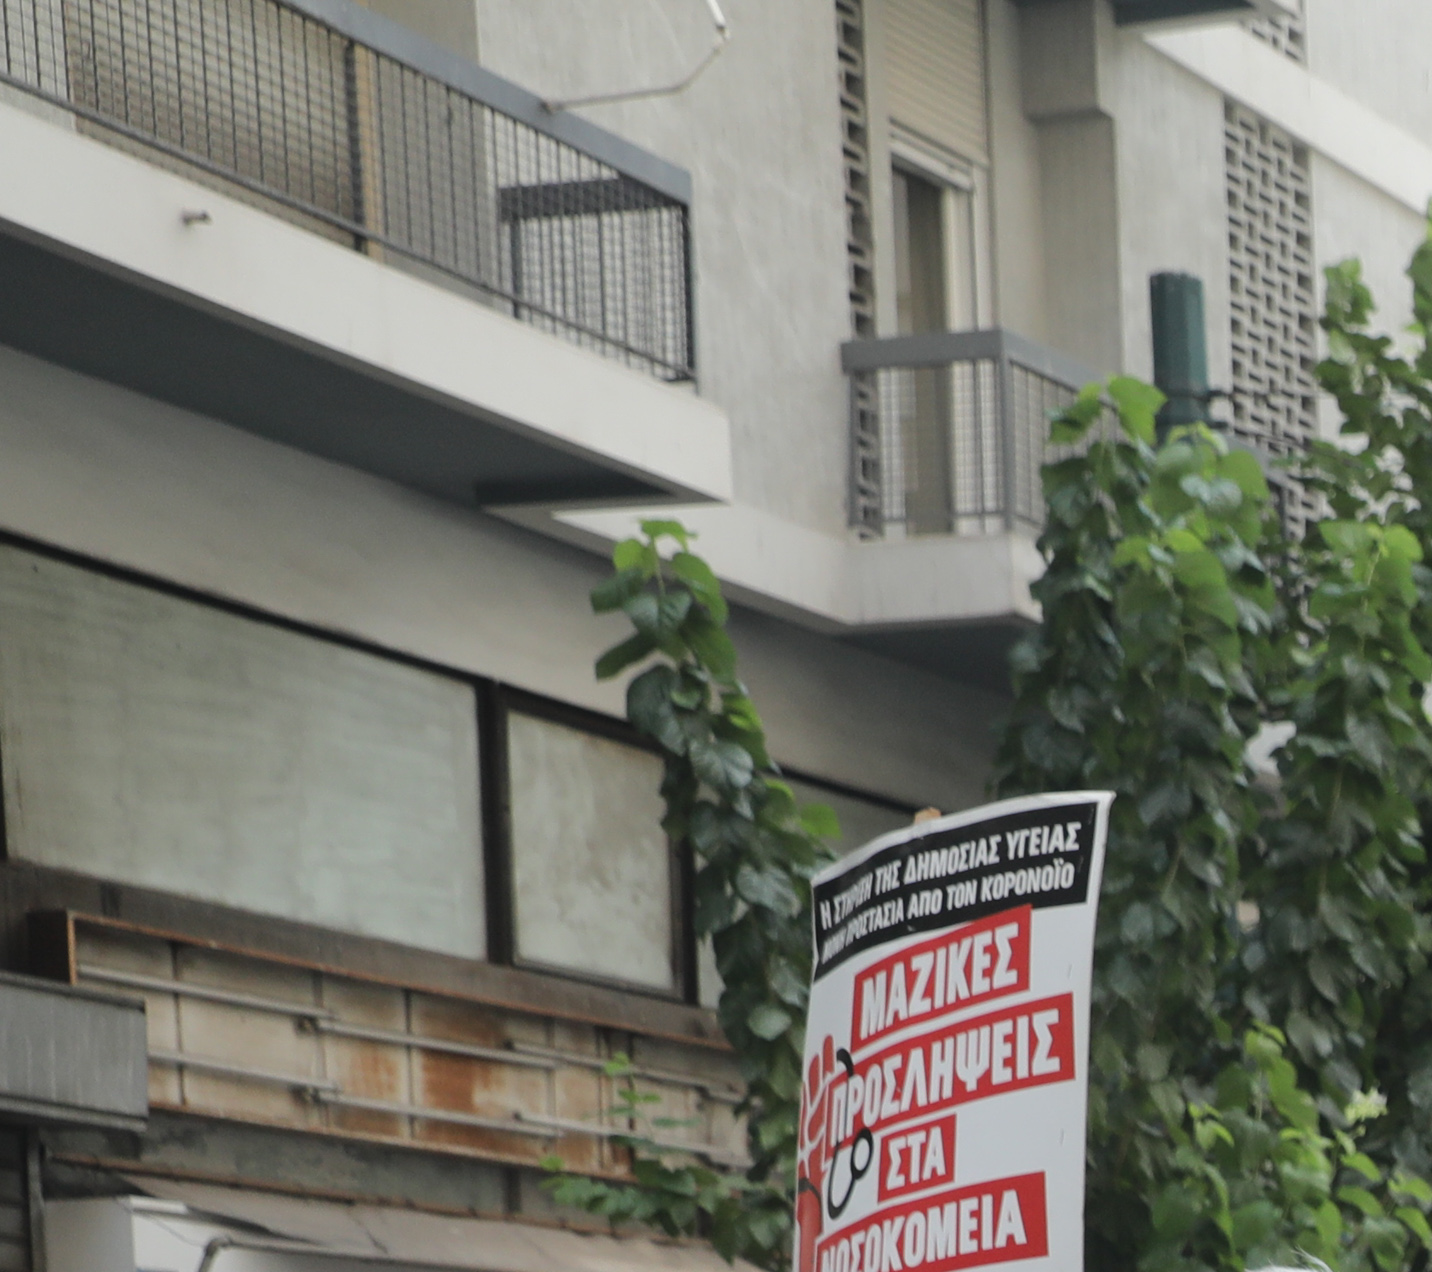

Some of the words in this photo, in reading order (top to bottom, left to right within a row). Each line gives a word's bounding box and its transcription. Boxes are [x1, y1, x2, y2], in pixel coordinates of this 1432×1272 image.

[820, 900, 832, 930] Η
[874, 860, 902, 897] ΤΗΣ
[903, 835, 1002, 885] ΔΗΜΟΣΙΑΣ
[1005, 821, 1082, 860] ΥΓΕΙΑΣ
[906, 886, 943, 920] ΑΠΟ
[945, 878, 978, 911] ΤΟΝ
[860, 922, 1019, 1040] ΜΑΖΙΚΕΣ
[829, 1008, 1061, 1148] ΠΡΟΣΛΗΨΕΙΣ
[886, 1126, 946, 1191] ΣΤΑ
